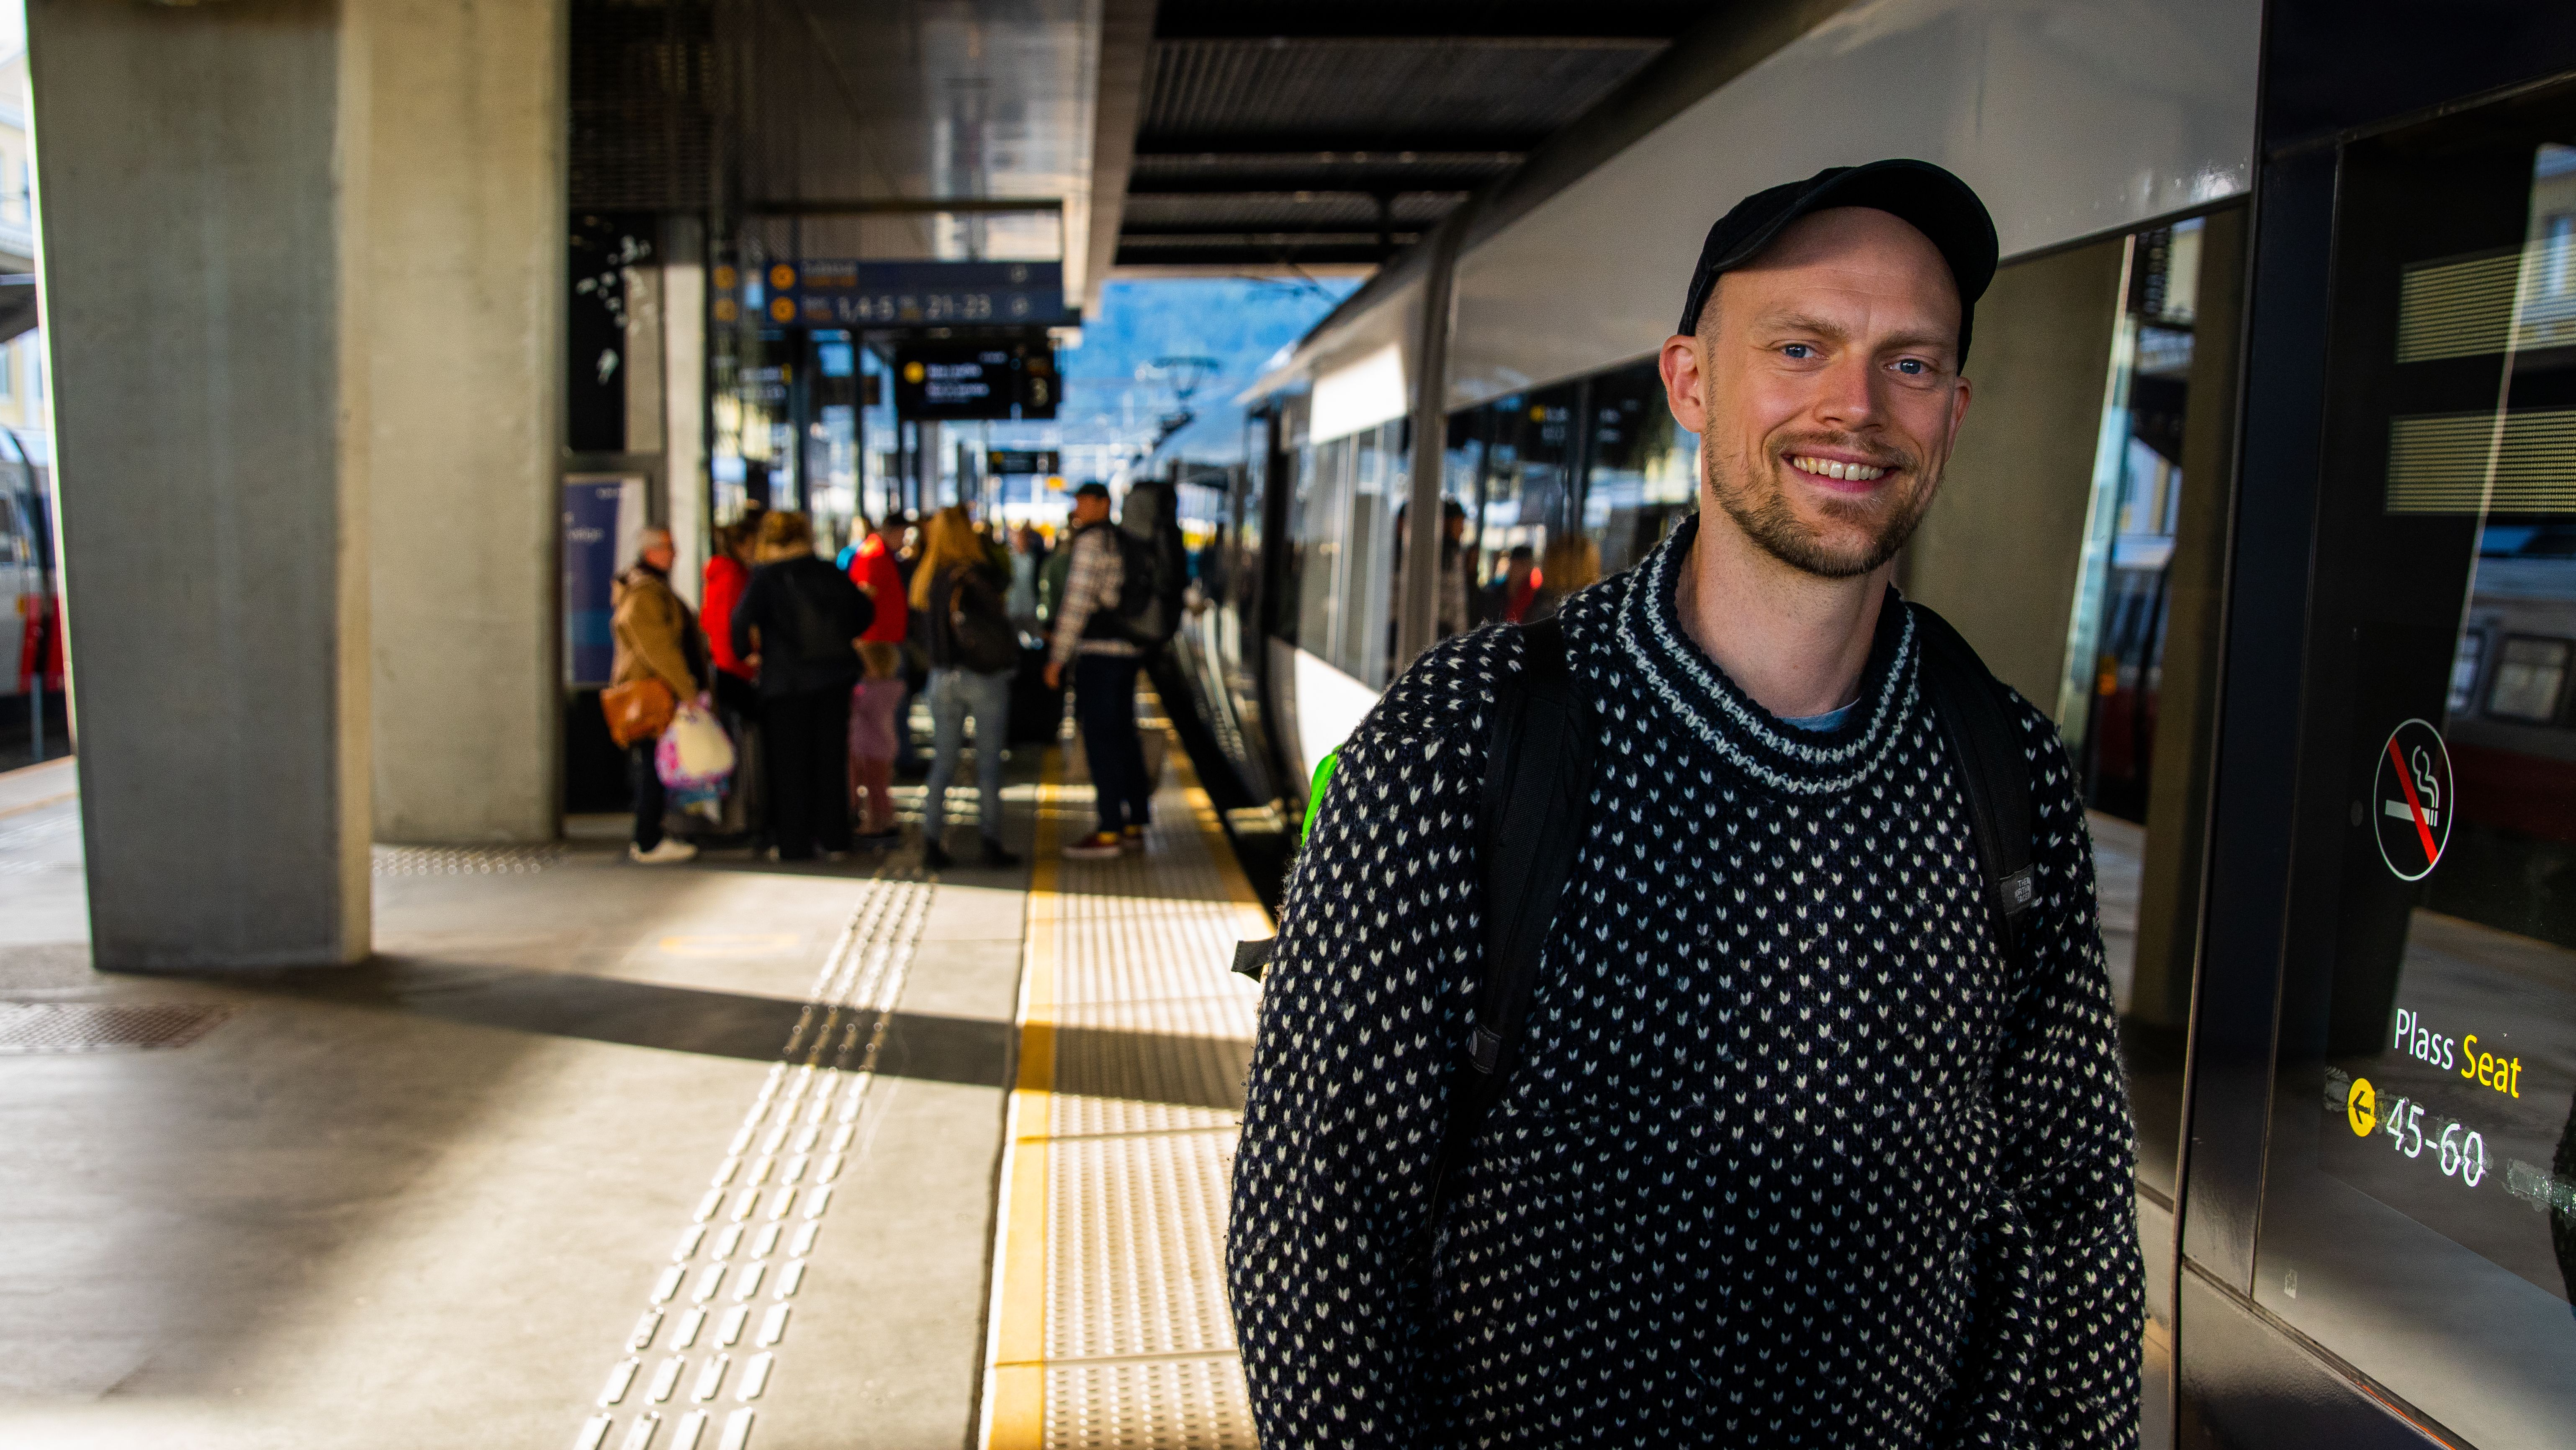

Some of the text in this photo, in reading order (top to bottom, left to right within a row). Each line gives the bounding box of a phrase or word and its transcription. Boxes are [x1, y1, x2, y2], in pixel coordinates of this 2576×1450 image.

[2017, 878, 2027, 887] THE
[2394, 1008, 2522, 1098] Plass Seat
[2386, 1098, 2483, 1187] 45-60
